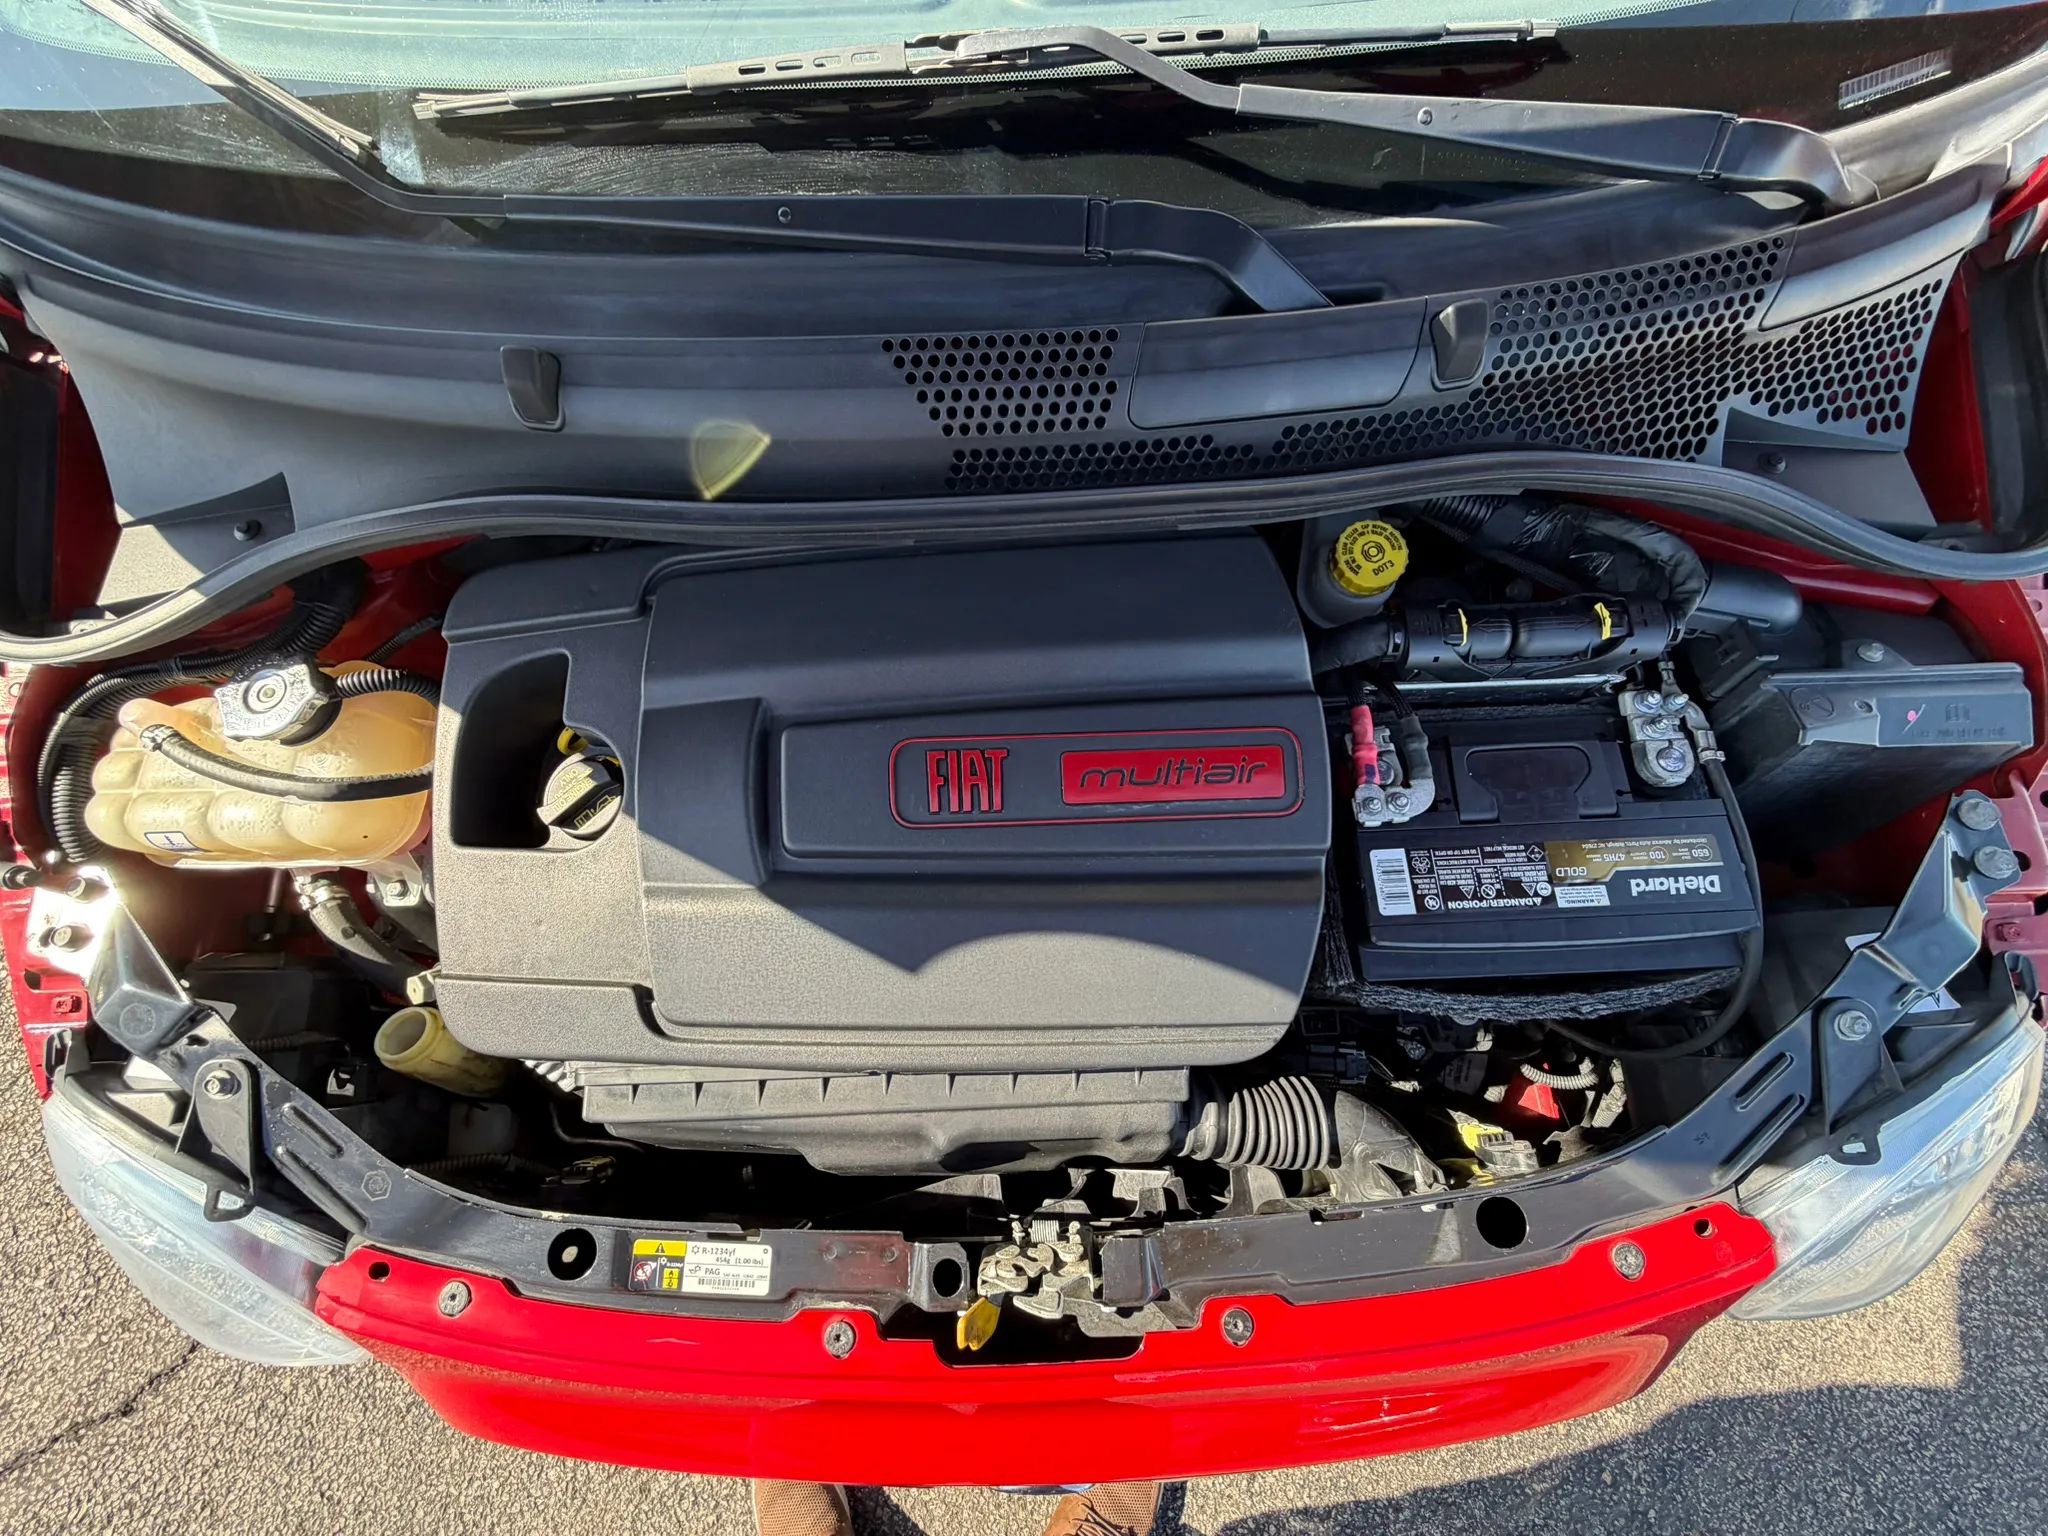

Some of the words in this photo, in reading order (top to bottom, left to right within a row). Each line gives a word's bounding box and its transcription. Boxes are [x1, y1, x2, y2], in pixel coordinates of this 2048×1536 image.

[1079, 755, 1268, 789] multiair
[925, 749, 1010, 815] FIAT
[1649, 850, 1666, 859] 100
[1692, 848, 1710, 857] 650
[1556, 867, 1587, 877] GOLD
[1630, 875, 1722, 896] DieHard
[702, 1248, 736, 1256] R-1234yf
[705, 1268, 720, 1276] PAG
